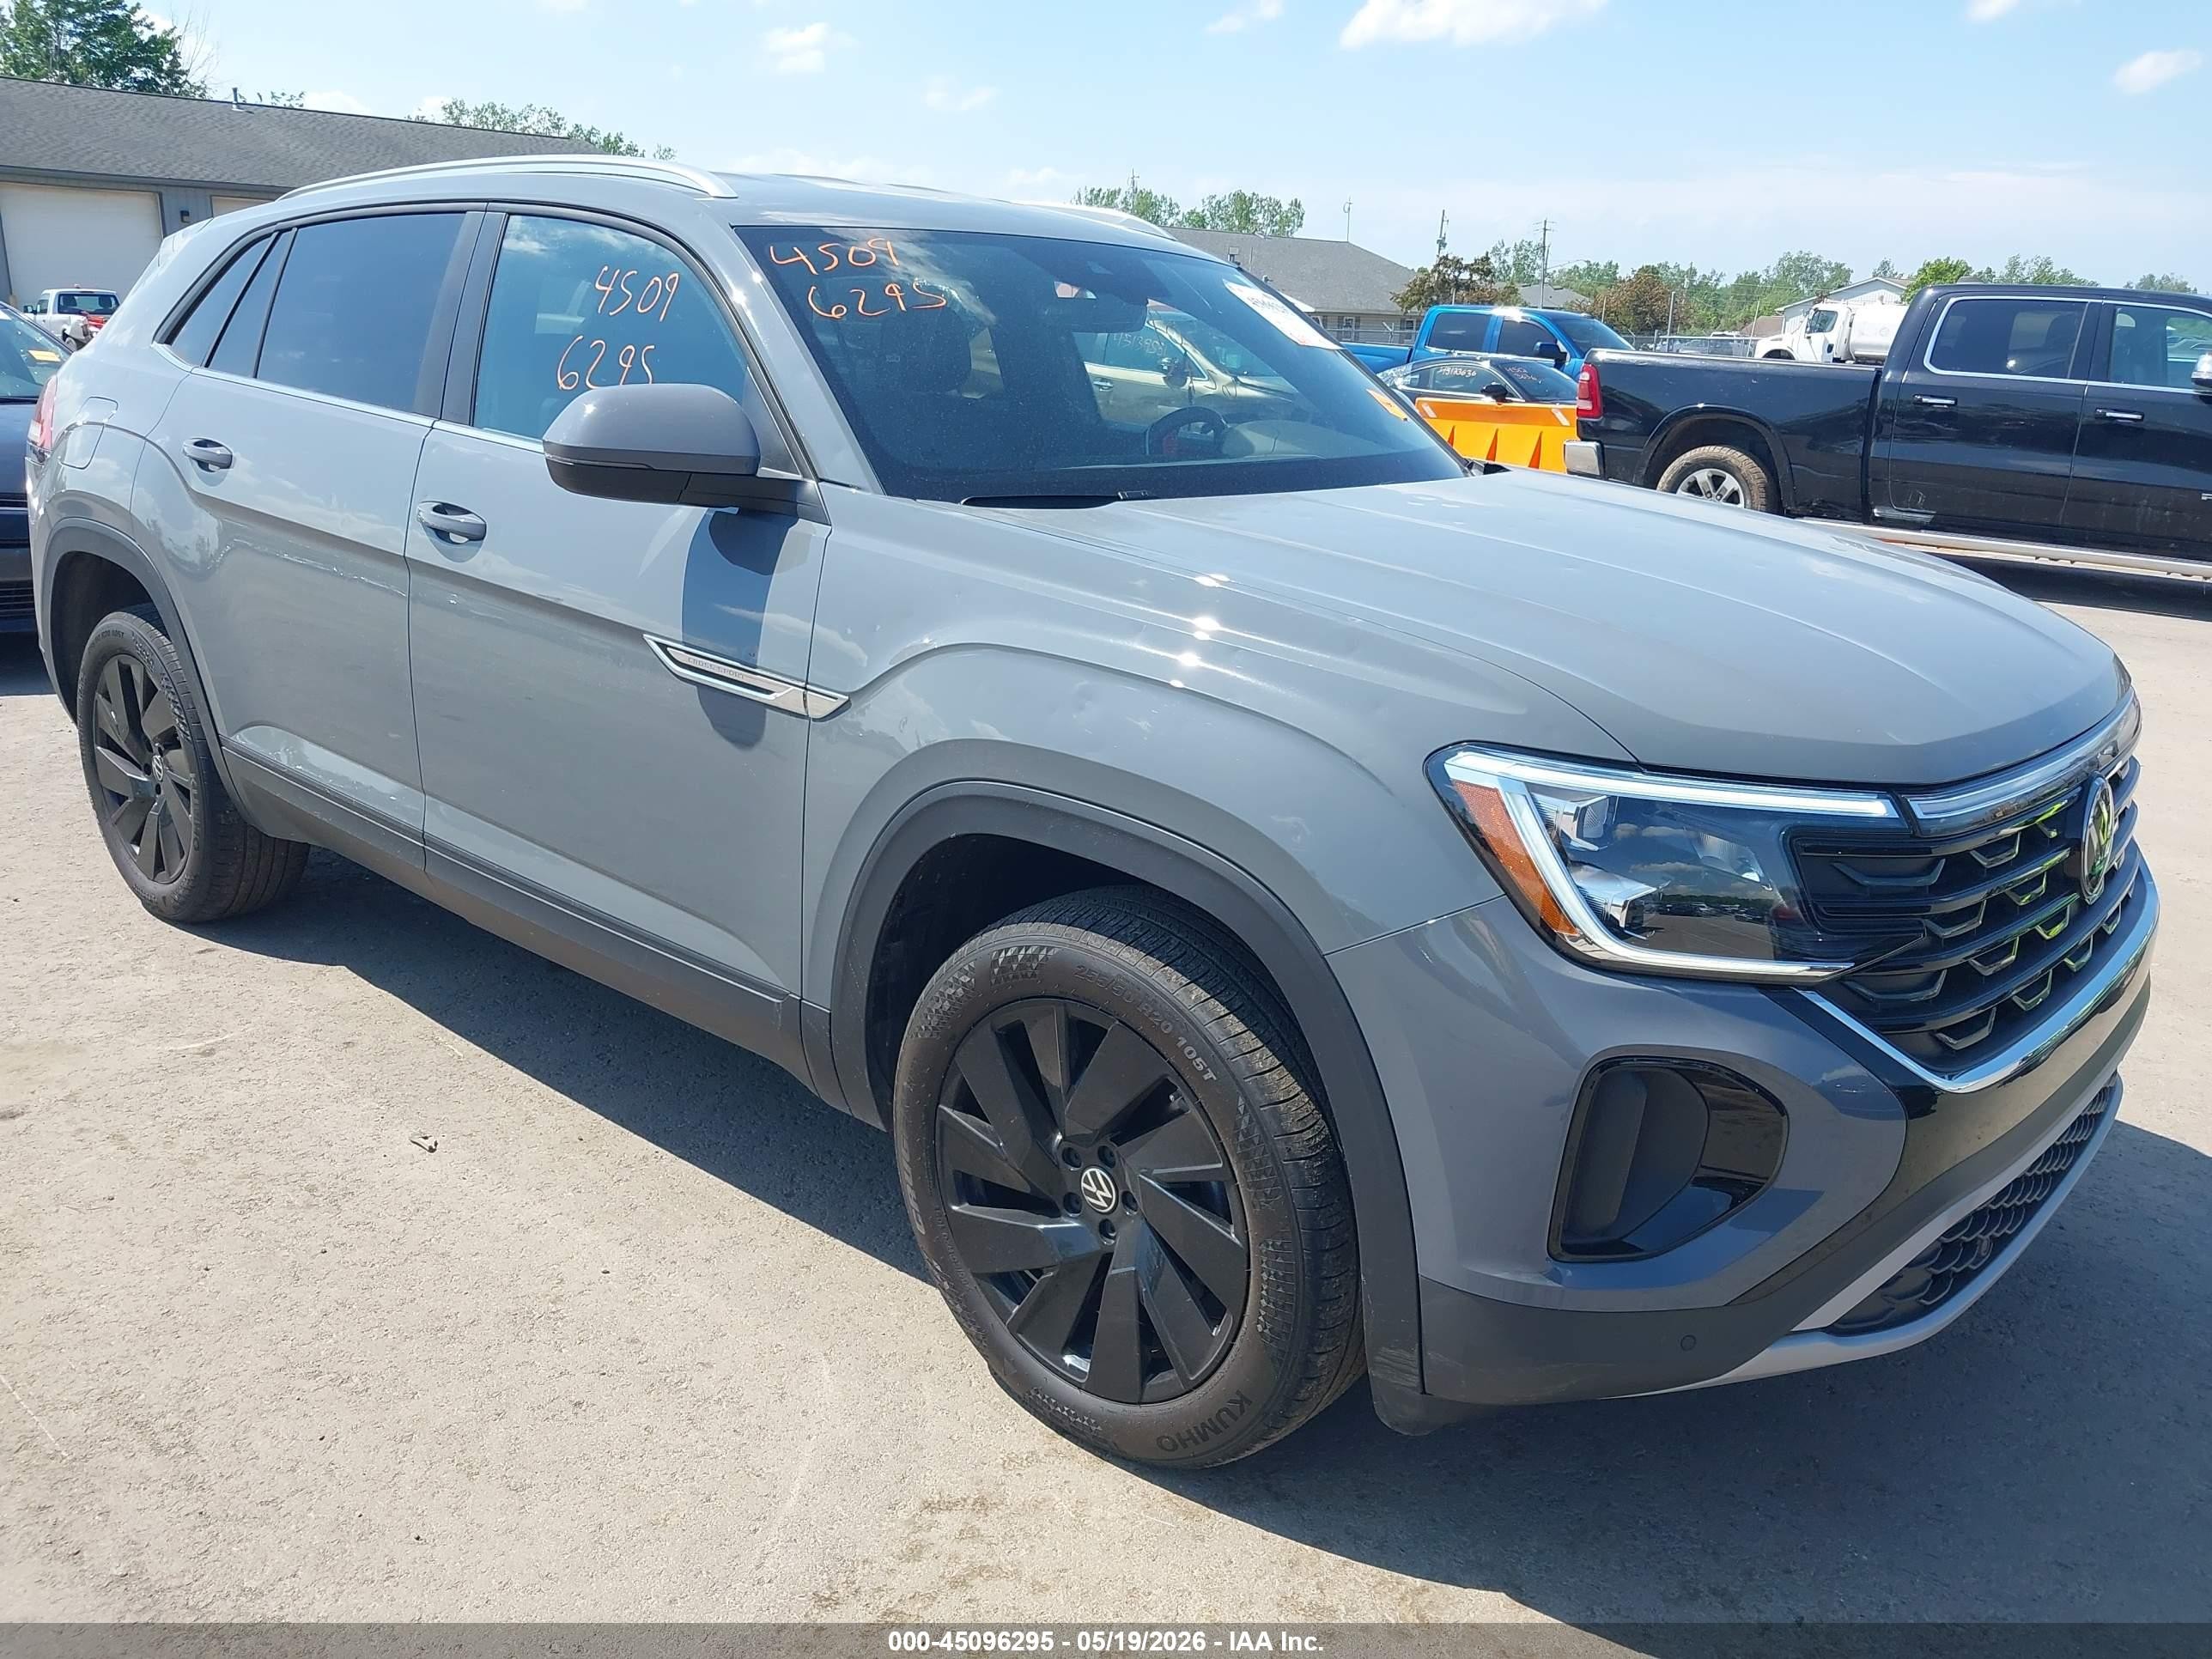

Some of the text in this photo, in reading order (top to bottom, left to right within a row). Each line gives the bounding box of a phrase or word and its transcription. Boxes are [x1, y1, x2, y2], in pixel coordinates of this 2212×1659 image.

[769, 238, 899, 276] 4509
[594, 265, 680, 322] 4509
[807, 277, 948, 320] 6295
[556, 335, 656, 391] 6295
[1175, 1036, 1217, 1082] 105T
[1156, 1389, 1252, 1452] KUMHO
